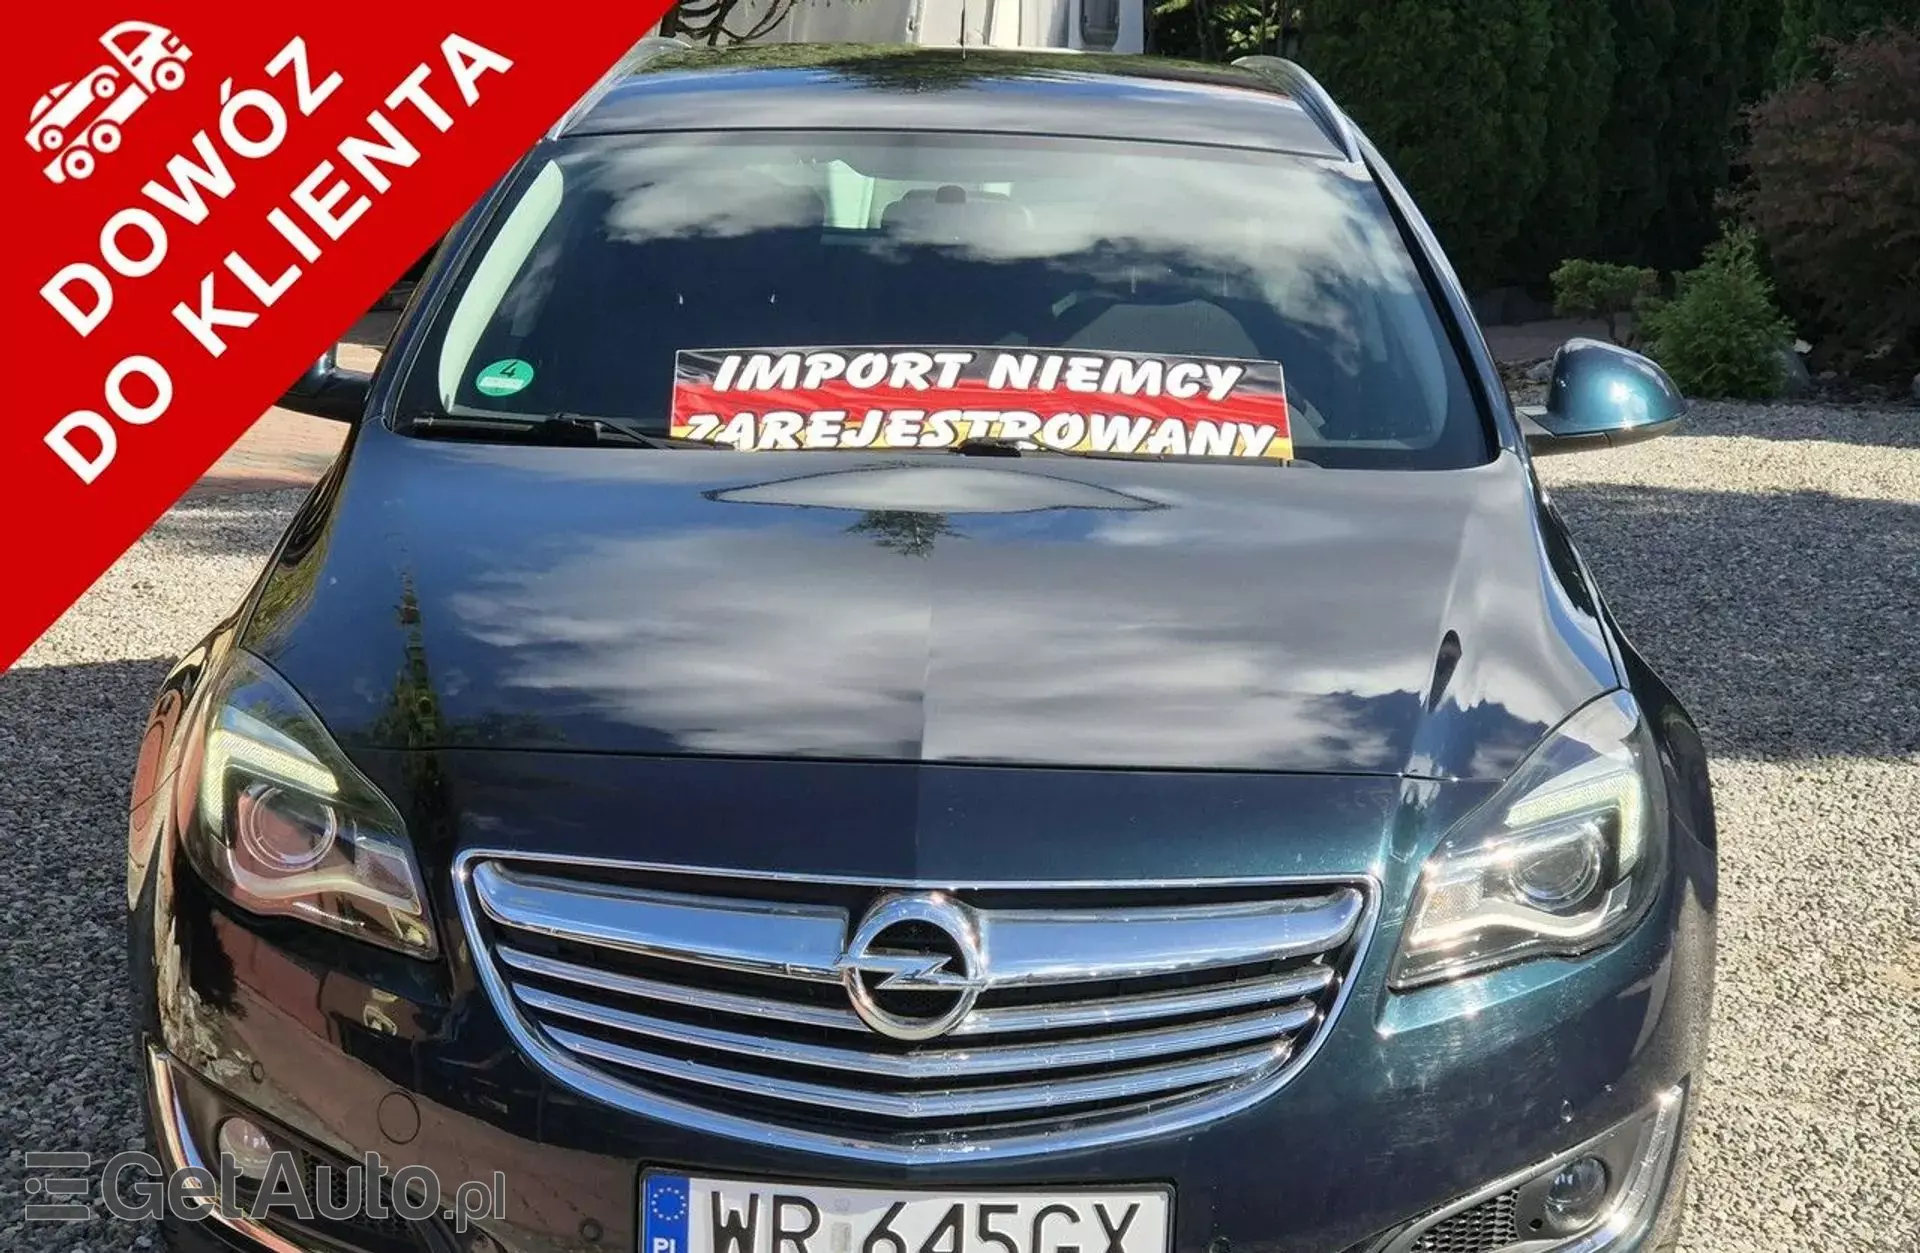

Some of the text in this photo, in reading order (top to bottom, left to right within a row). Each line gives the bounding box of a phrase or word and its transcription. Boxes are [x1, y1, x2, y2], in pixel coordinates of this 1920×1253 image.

[500, 361, 518, 377] 4
[713, 352, 1243, 401] IMPORT NIEMCY
[686, 409, 1276, 457] ZAREJESTROWANY
[711, 1191, 1141, 1253] WR 645GX
